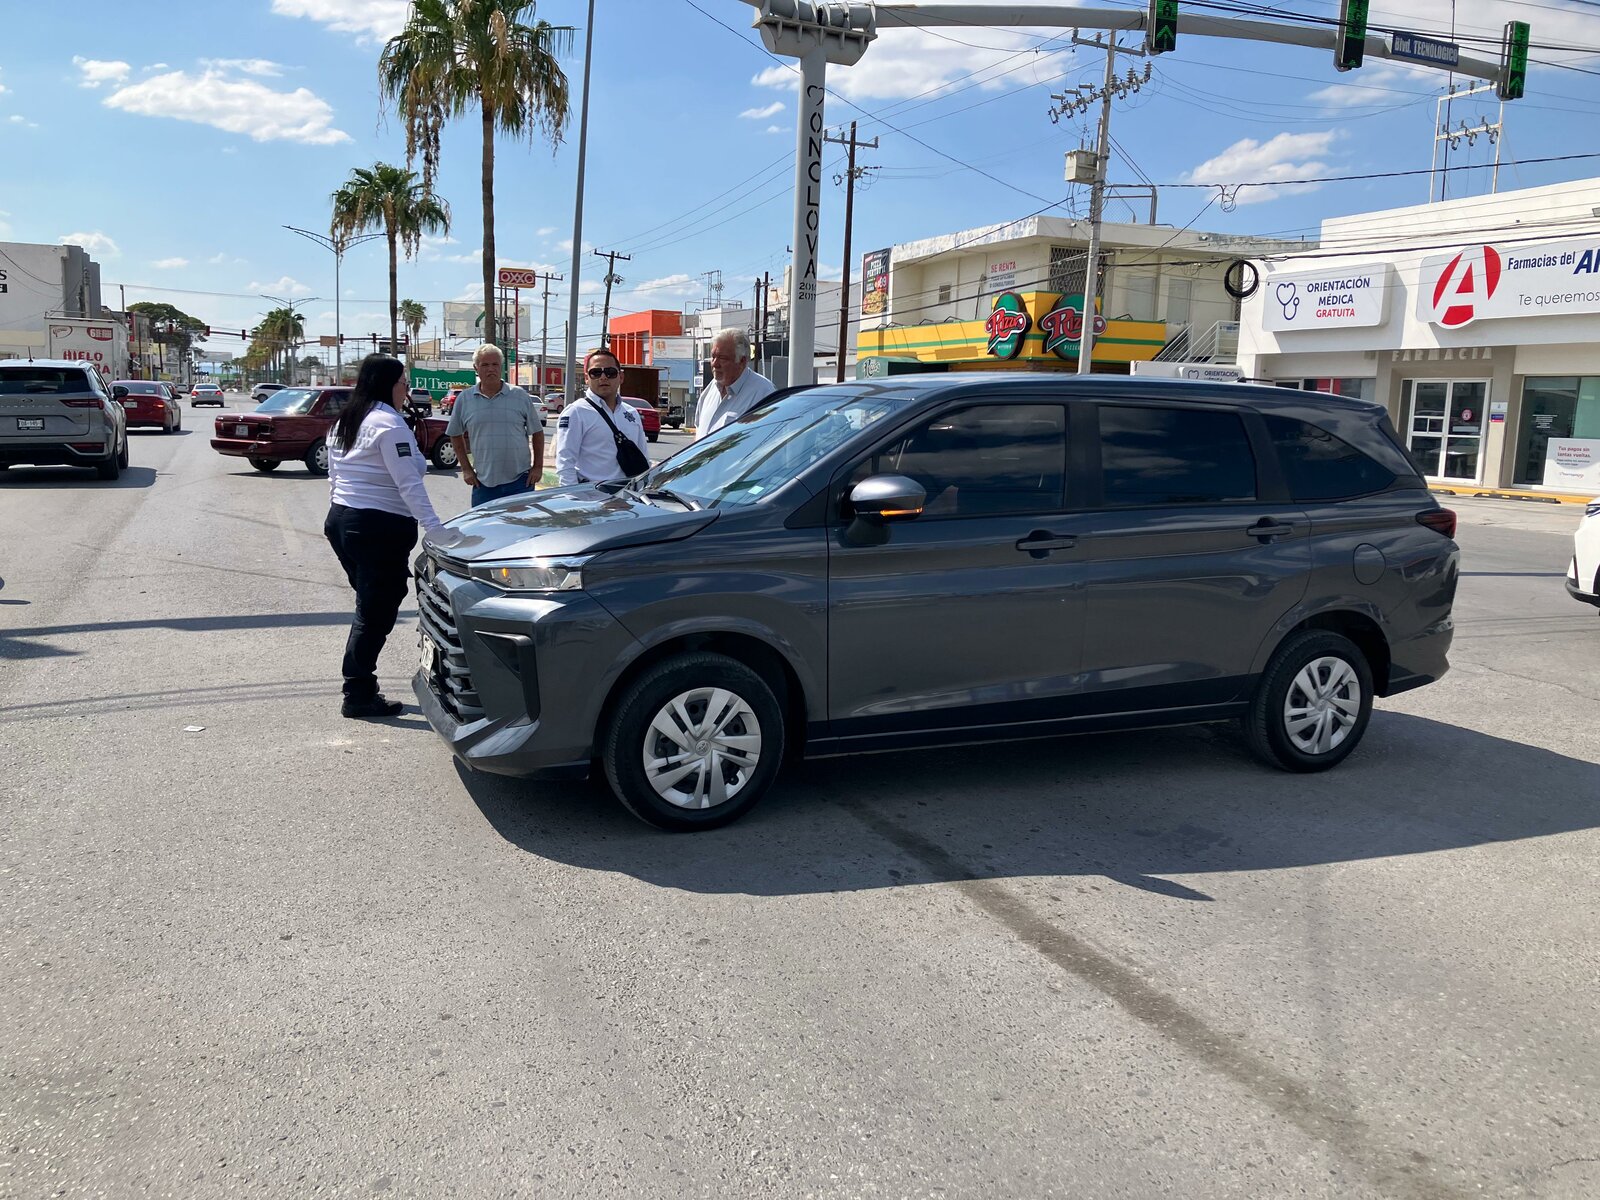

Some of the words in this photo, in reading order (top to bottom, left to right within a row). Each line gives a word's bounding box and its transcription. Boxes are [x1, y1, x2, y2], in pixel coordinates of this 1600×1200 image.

[1394, 36, 1412, 54] Blvd.
[1413, 40, 1458, 62] TECNOLOGICO
[990, 264, 998, 273] SE
[999, 260, 1017, 272] RENTA
[1507, 254, 1558, 271] Farmacias
[1560, 251, 1576, 265] del
[500, 271, 535, 285] OXXO
[1307, 276, 1371, 292] ORIENTACIÓN
[1318, 293, 1354, 306] MÉDICA
[1519, 294, 1532, 306] Te
[1535, 291, 1600, 307] queremos
[1316, 308, 1355, 318] GRATUITA
[63, 350, 103, 362] HIELO
[1391, 347, 1493, 361] FARMACIA
[1204, 370, 1239, 378] ORIENTACIÓN
[415, 377, 427, 390] El
